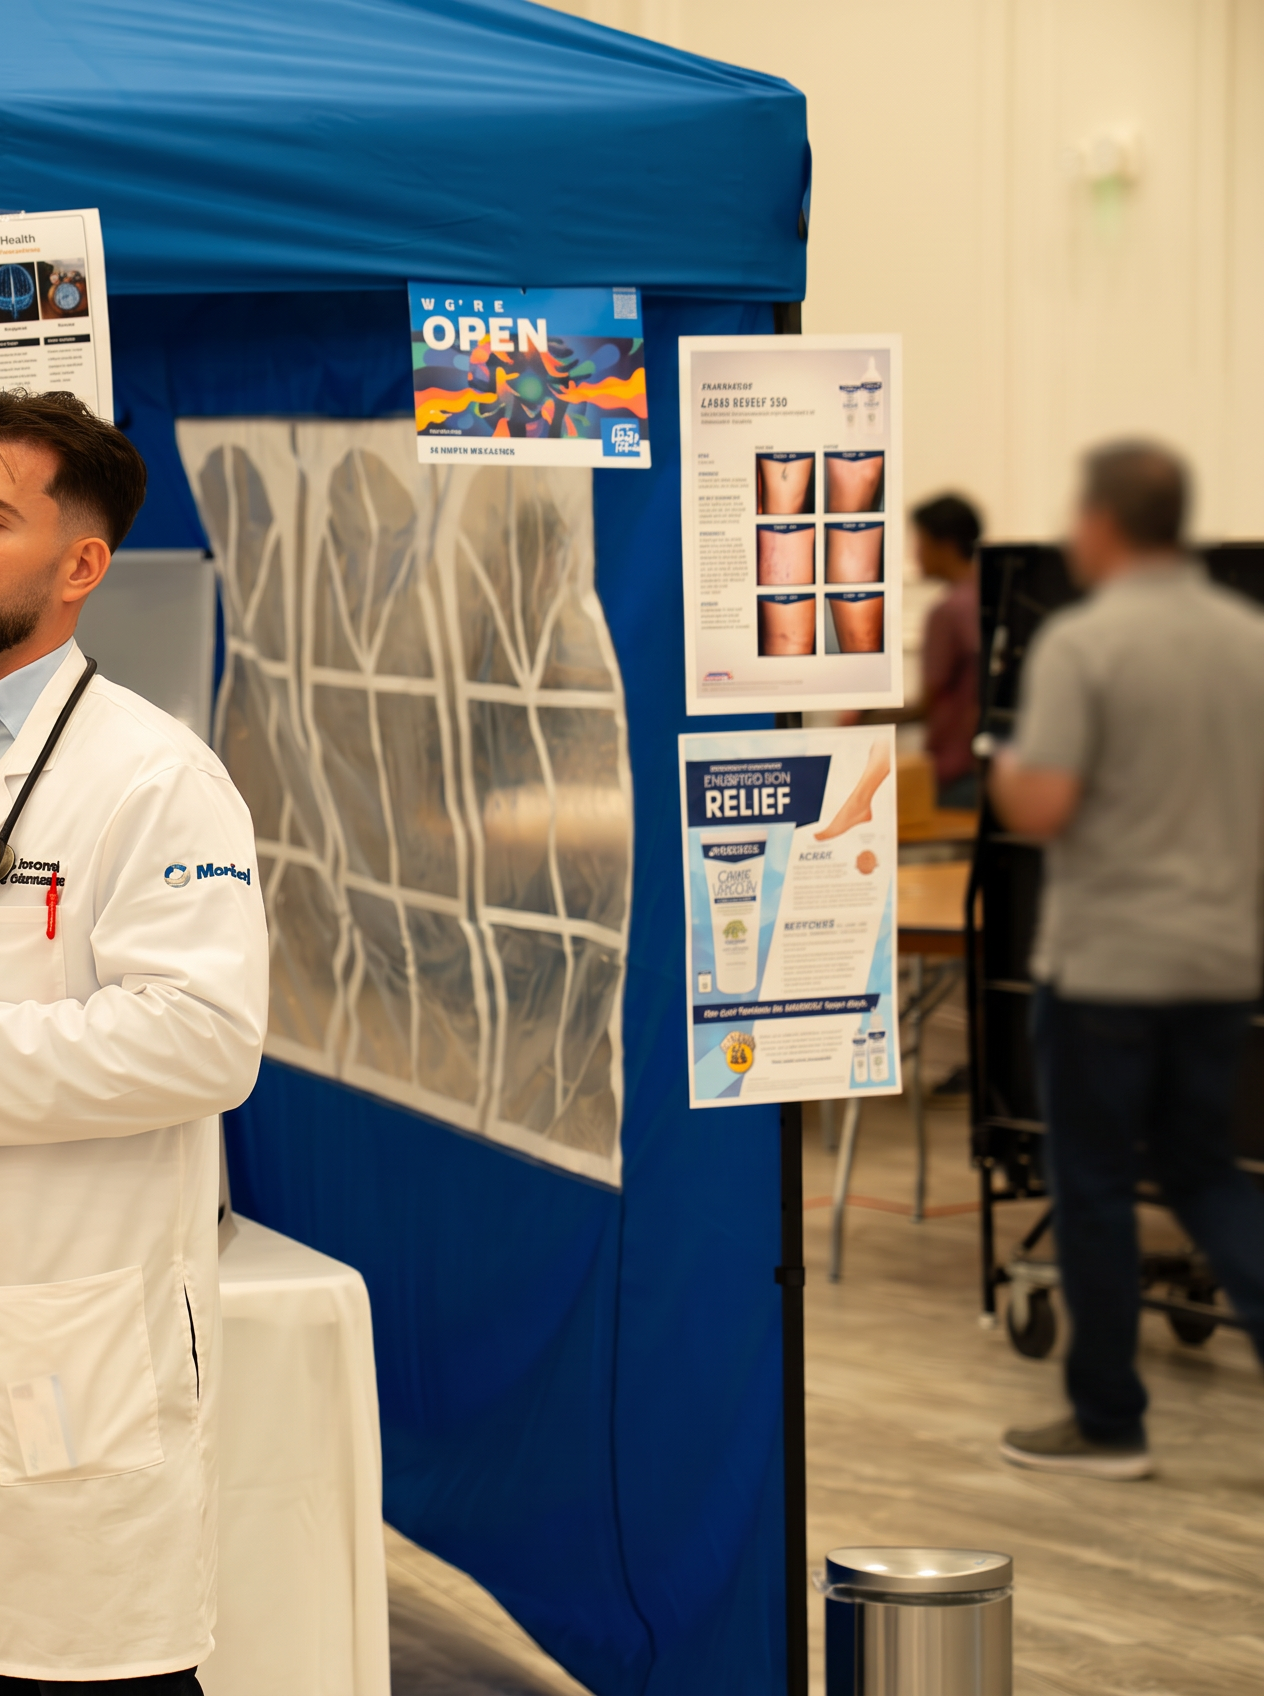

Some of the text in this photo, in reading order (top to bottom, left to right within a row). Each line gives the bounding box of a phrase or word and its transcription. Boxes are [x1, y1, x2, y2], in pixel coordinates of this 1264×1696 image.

[0, 234, 36, 246] Health
[422, 315, 549, 353] OPEN
[705, 786, 791, 819] RELIEF
